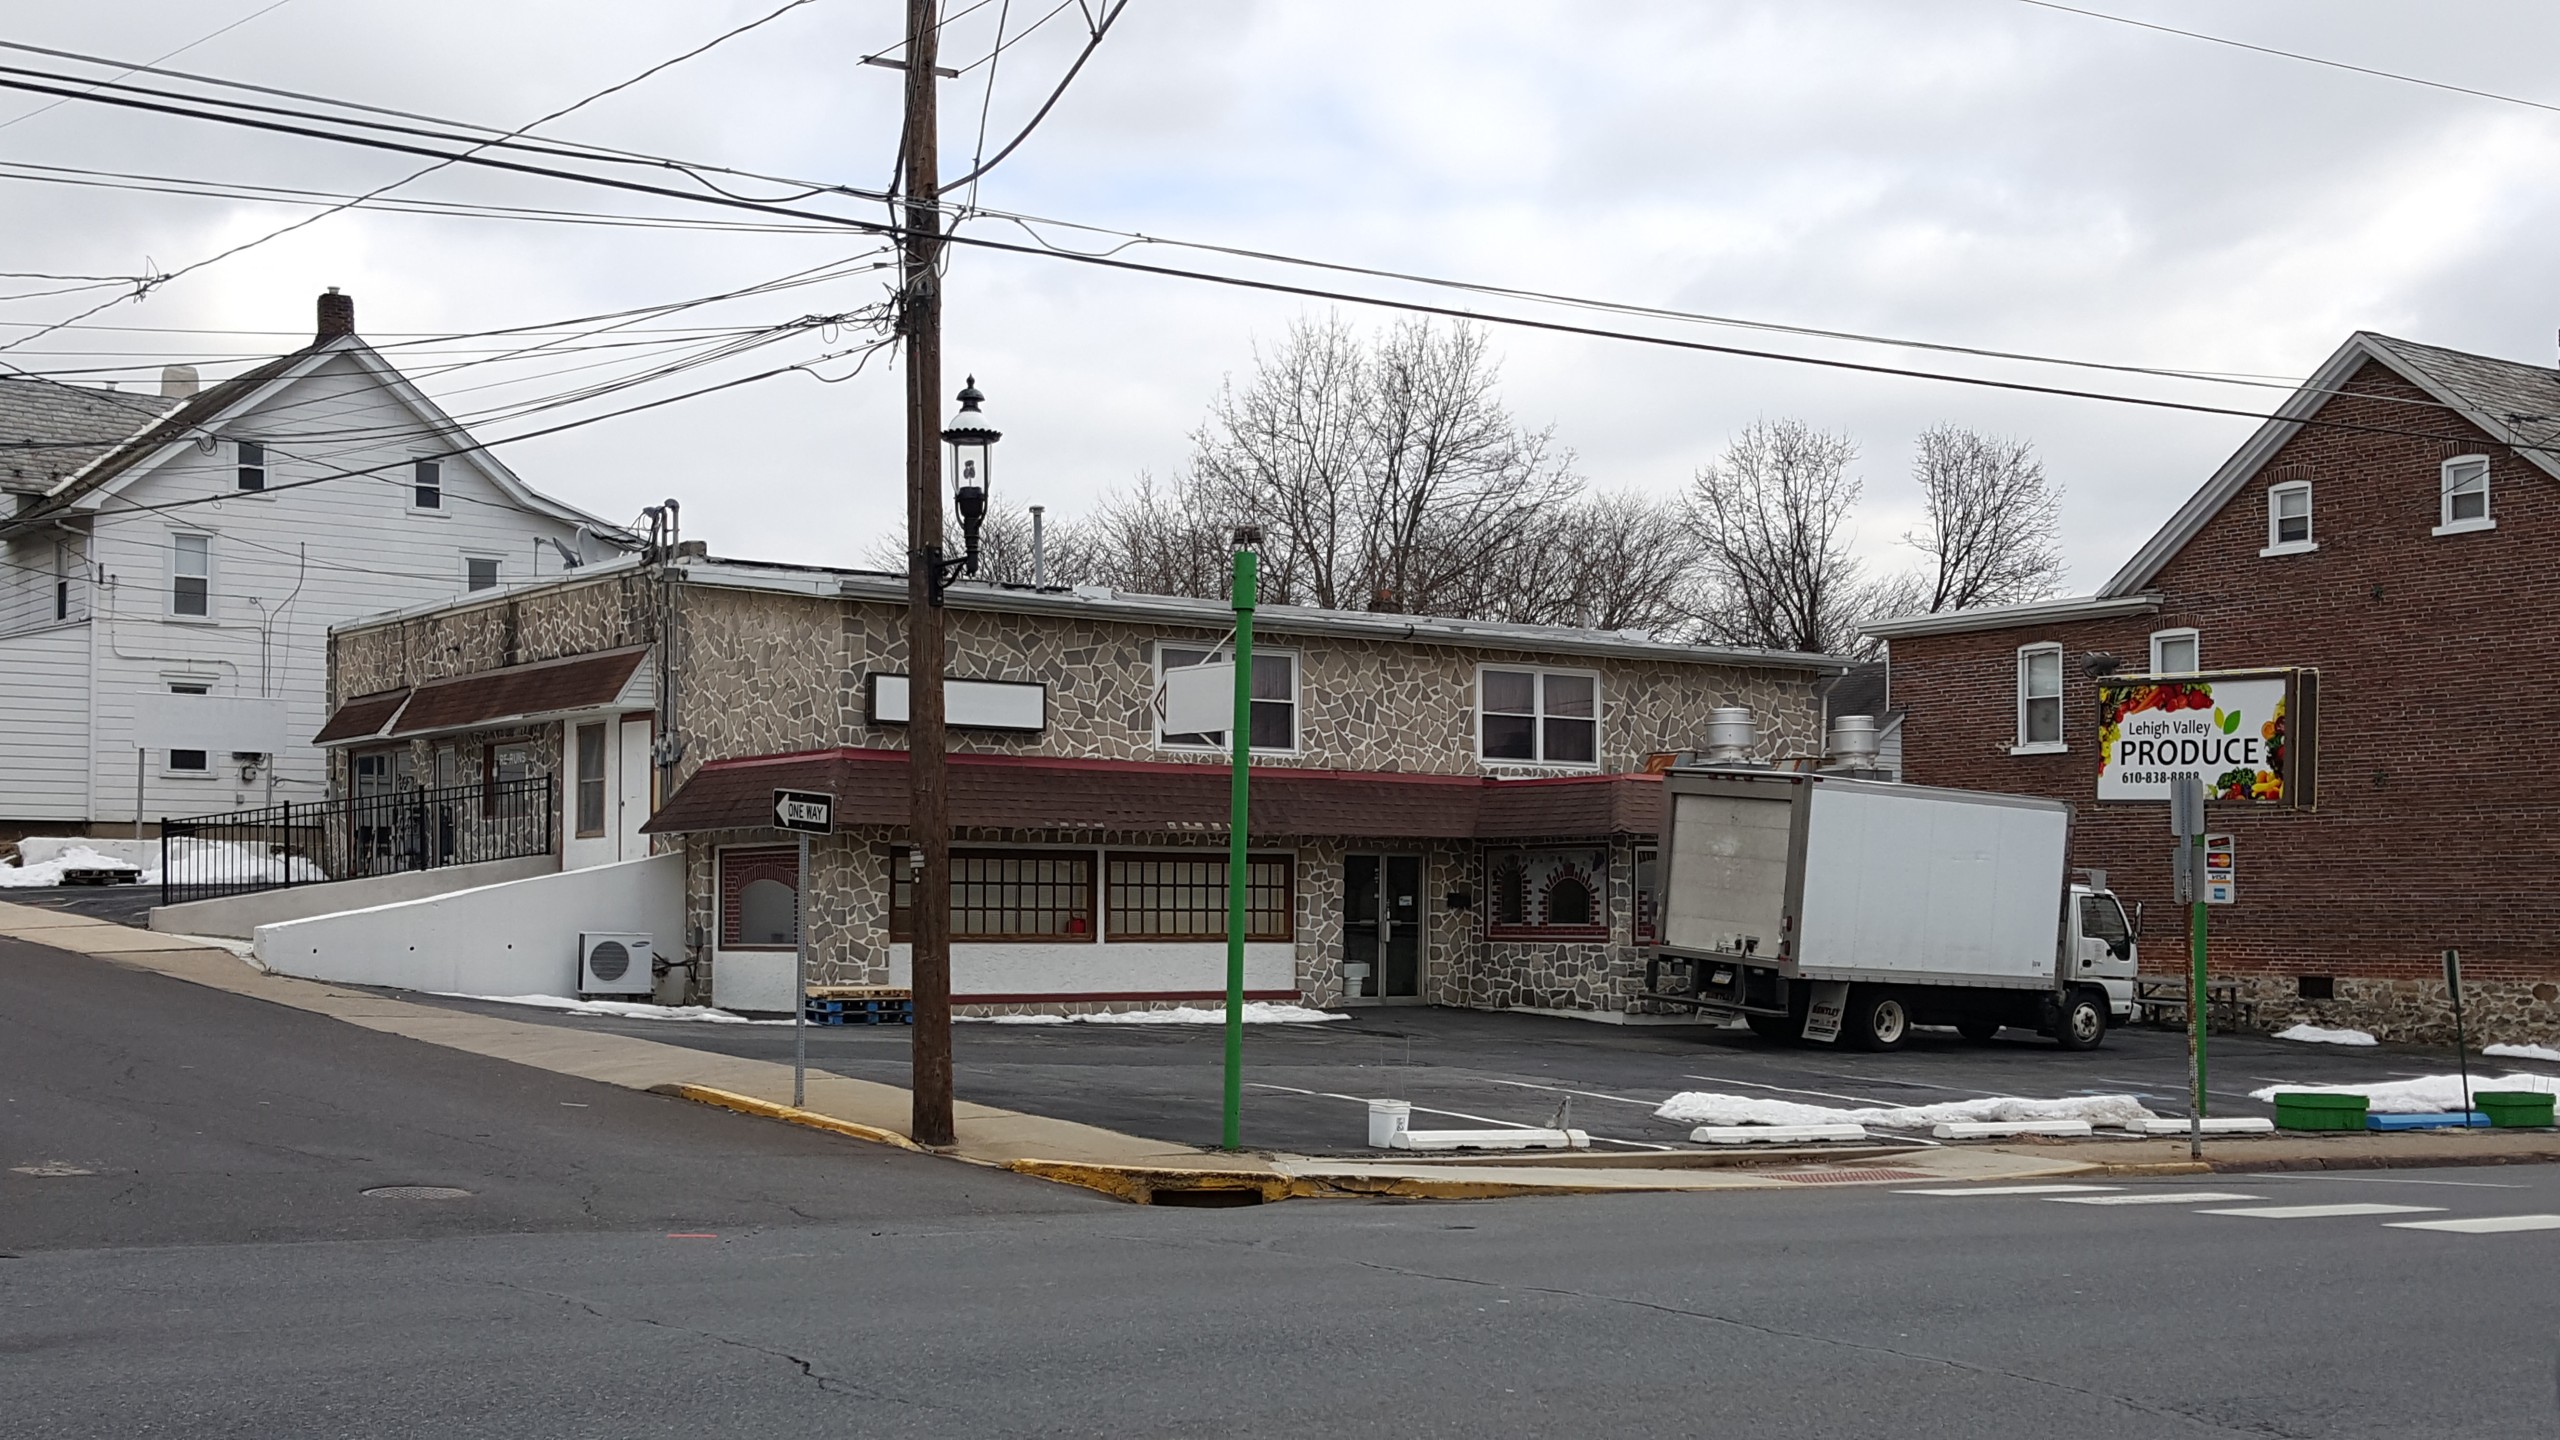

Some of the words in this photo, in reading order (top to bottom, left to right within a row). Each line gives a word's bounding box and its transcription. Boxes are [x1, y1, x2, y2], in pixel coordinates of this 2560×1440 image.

[2129, 721, 2170, 739] Lehigh
[2173, 720, 2211, 737] Valley
[2120, 738, 2259, 766] PRODUCE
[788, 803, 804, 819] ONE
[806, 805, 823, 821] WAY
